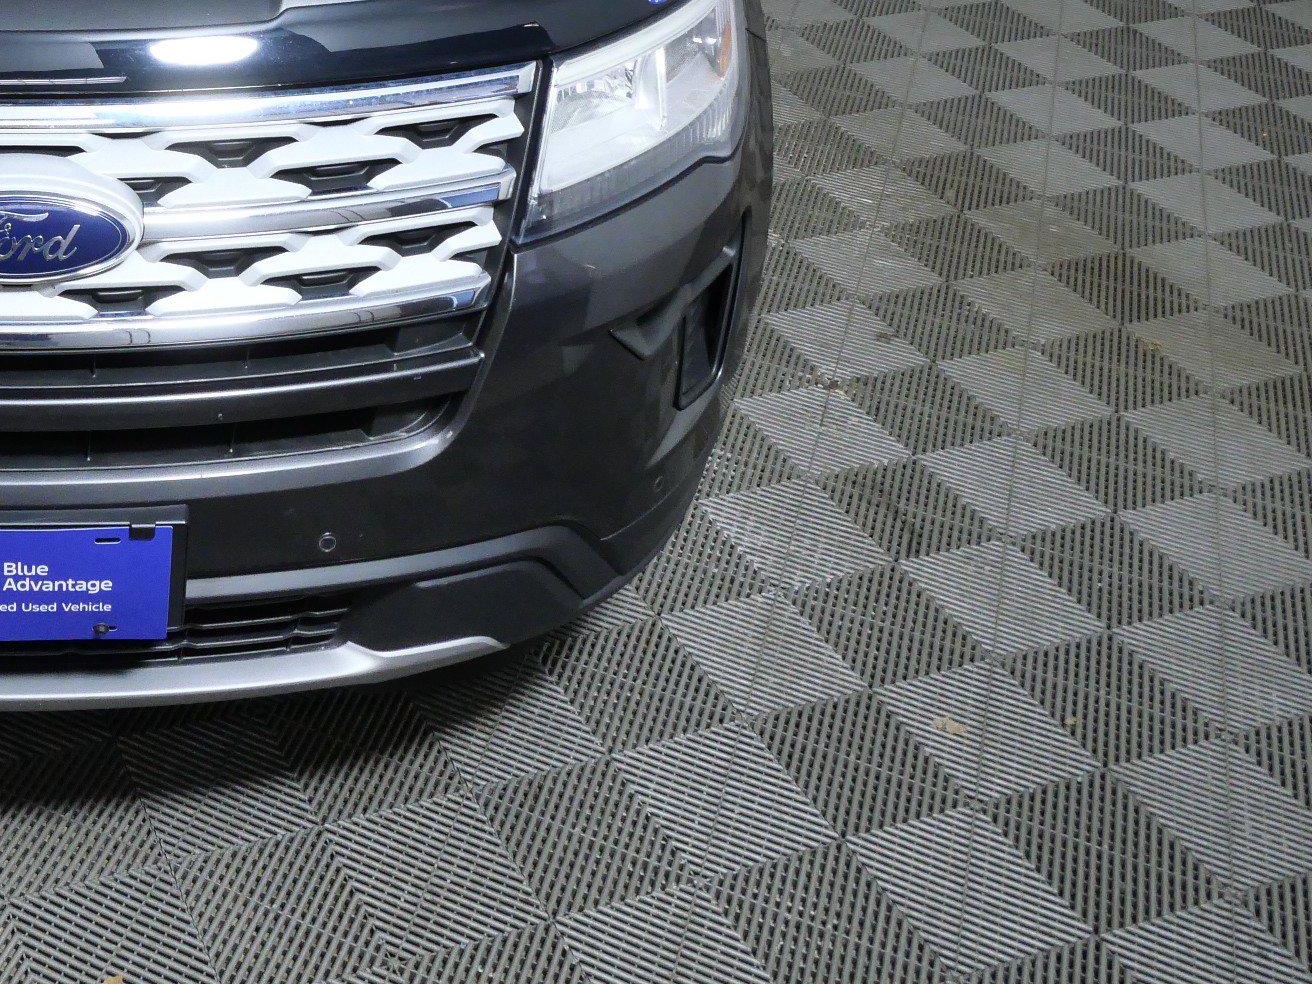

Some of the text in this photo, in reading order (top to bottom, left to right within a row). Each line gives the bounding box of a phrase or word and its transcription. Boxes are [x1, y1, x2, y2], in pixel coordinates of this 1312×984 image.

[3, 562, 49, 576] Blue
[2, 577, 113, 594] Advantage
[21, 602, 57, 613] Used
[61, 602, 112, 613] Vehicle
